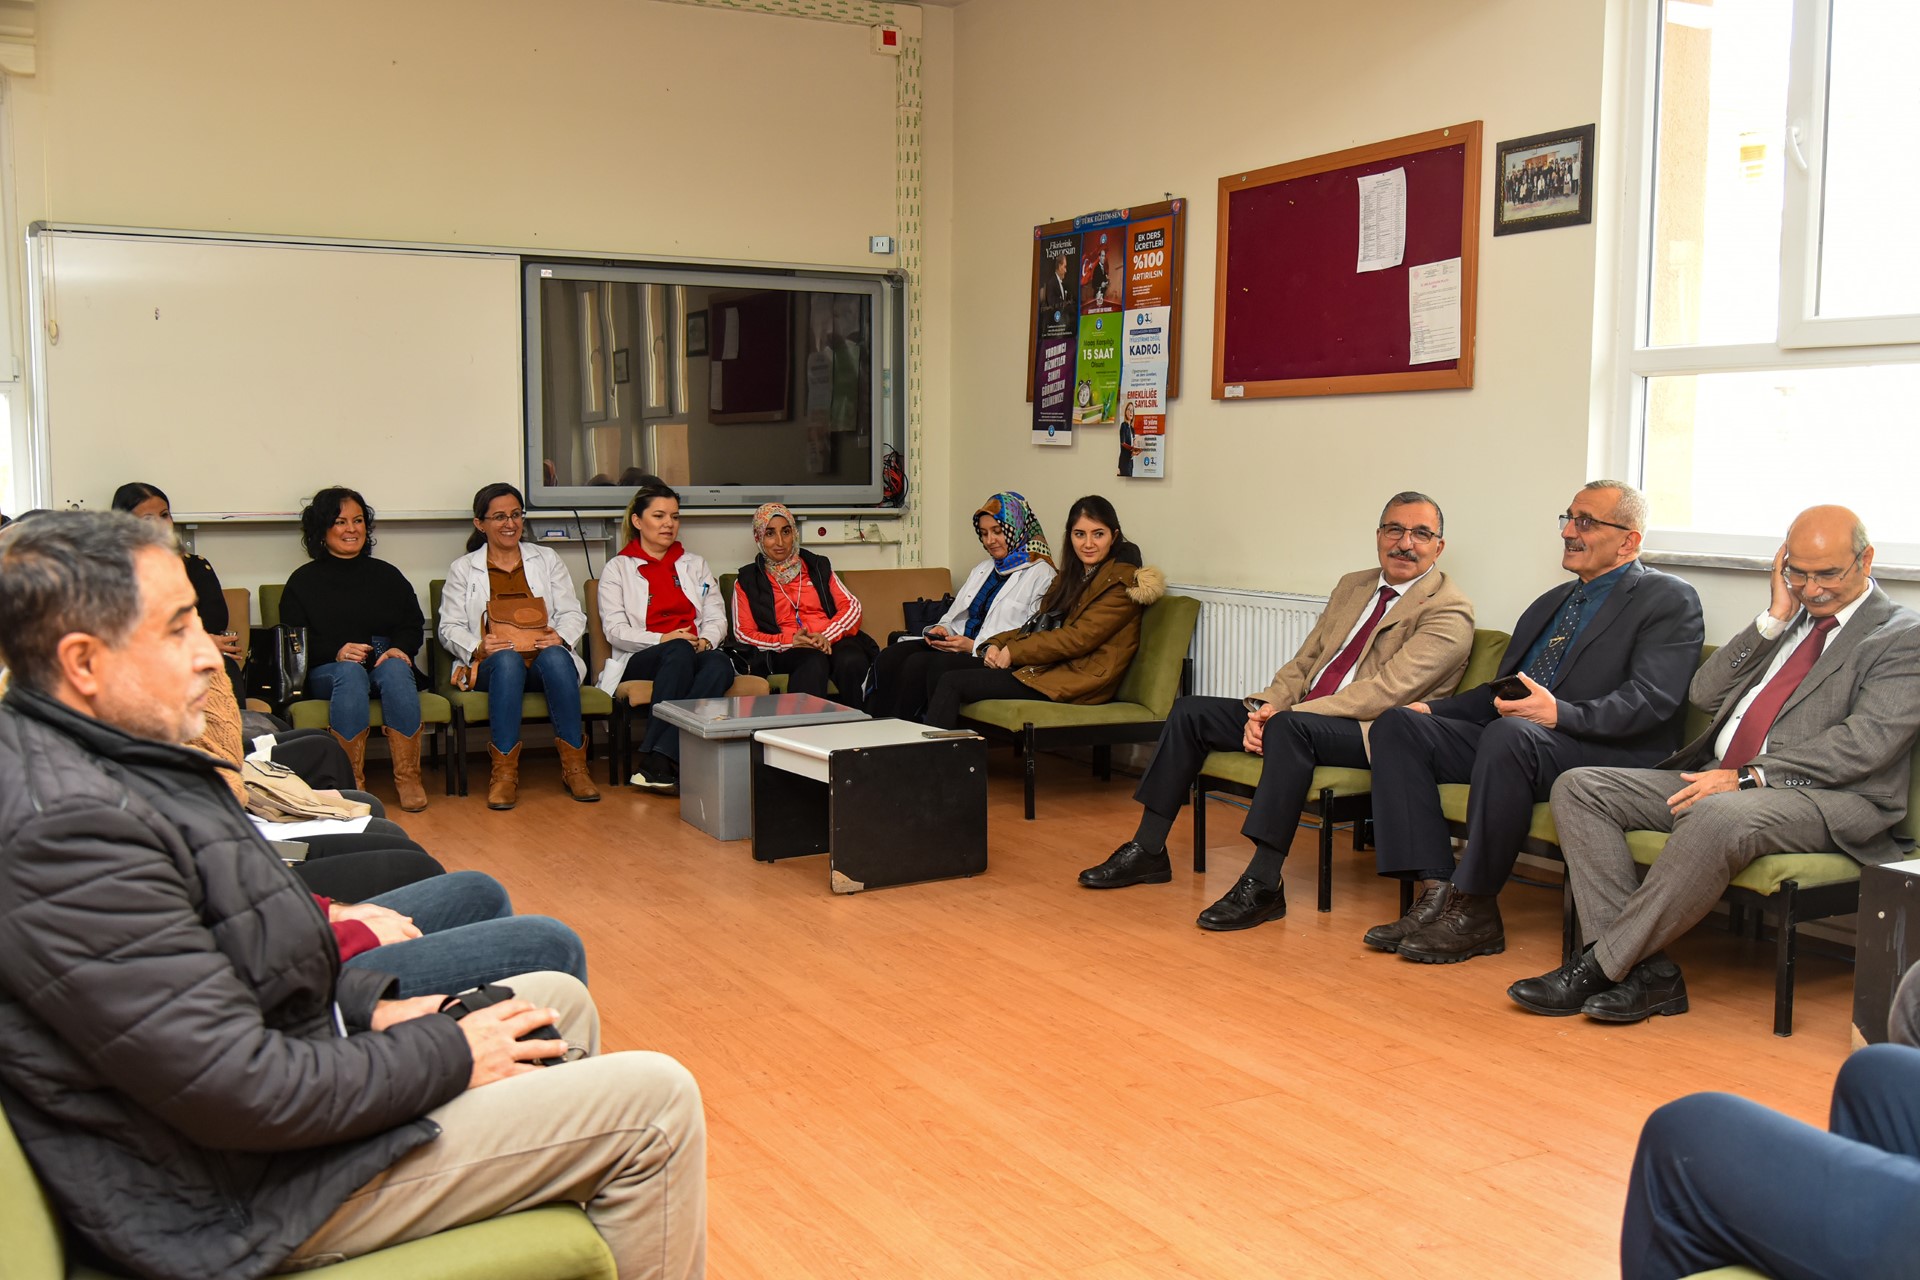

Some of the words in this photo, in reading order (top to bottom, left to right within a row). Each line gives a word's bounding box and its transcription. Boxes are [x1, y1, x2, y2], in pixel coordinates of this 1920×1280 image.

[1138, 234, 1146, 242] EK
[1146, 230, 1161, 240] DERS
[1134, 238, 1164, 251] ÜCRETLERİ
[1133, 250, 1164, 270] %100
[1132, 269, 1163, 281] ARTIRILSIN
[1083, 349, 1092, 360] 15
[1093, 347, 1114, 360] SAAT
[1129, 344, 1161, 356] KADRO!
[1127, 388, 1157, 400] EMEKLİLİĞE
[1135, 399, 1158, 408] SAYILSIN.
